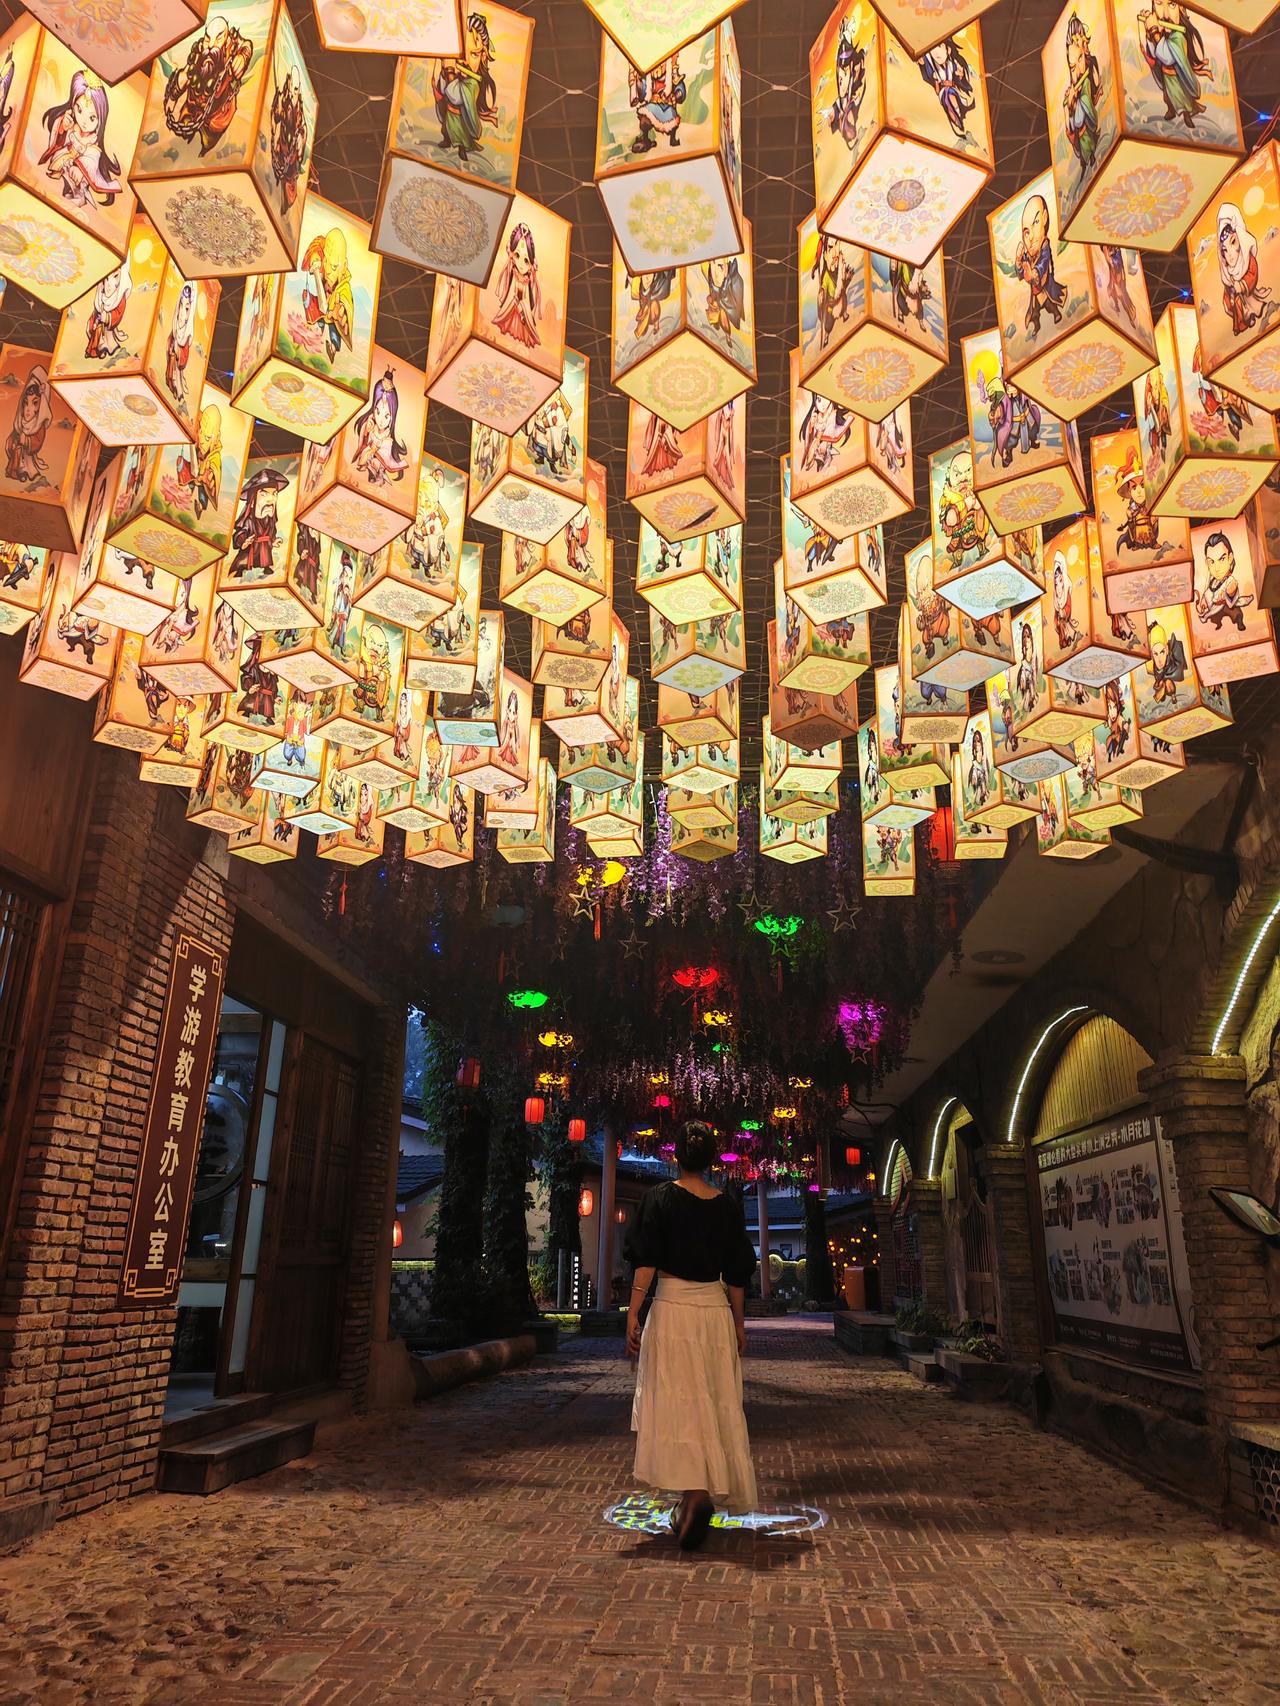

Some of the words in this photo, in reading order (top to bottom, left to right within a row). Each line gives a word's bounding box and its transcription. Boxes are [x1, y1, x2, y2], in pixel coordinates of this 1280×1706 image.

[144, 964, 207, 1270] 学游教育办公室
